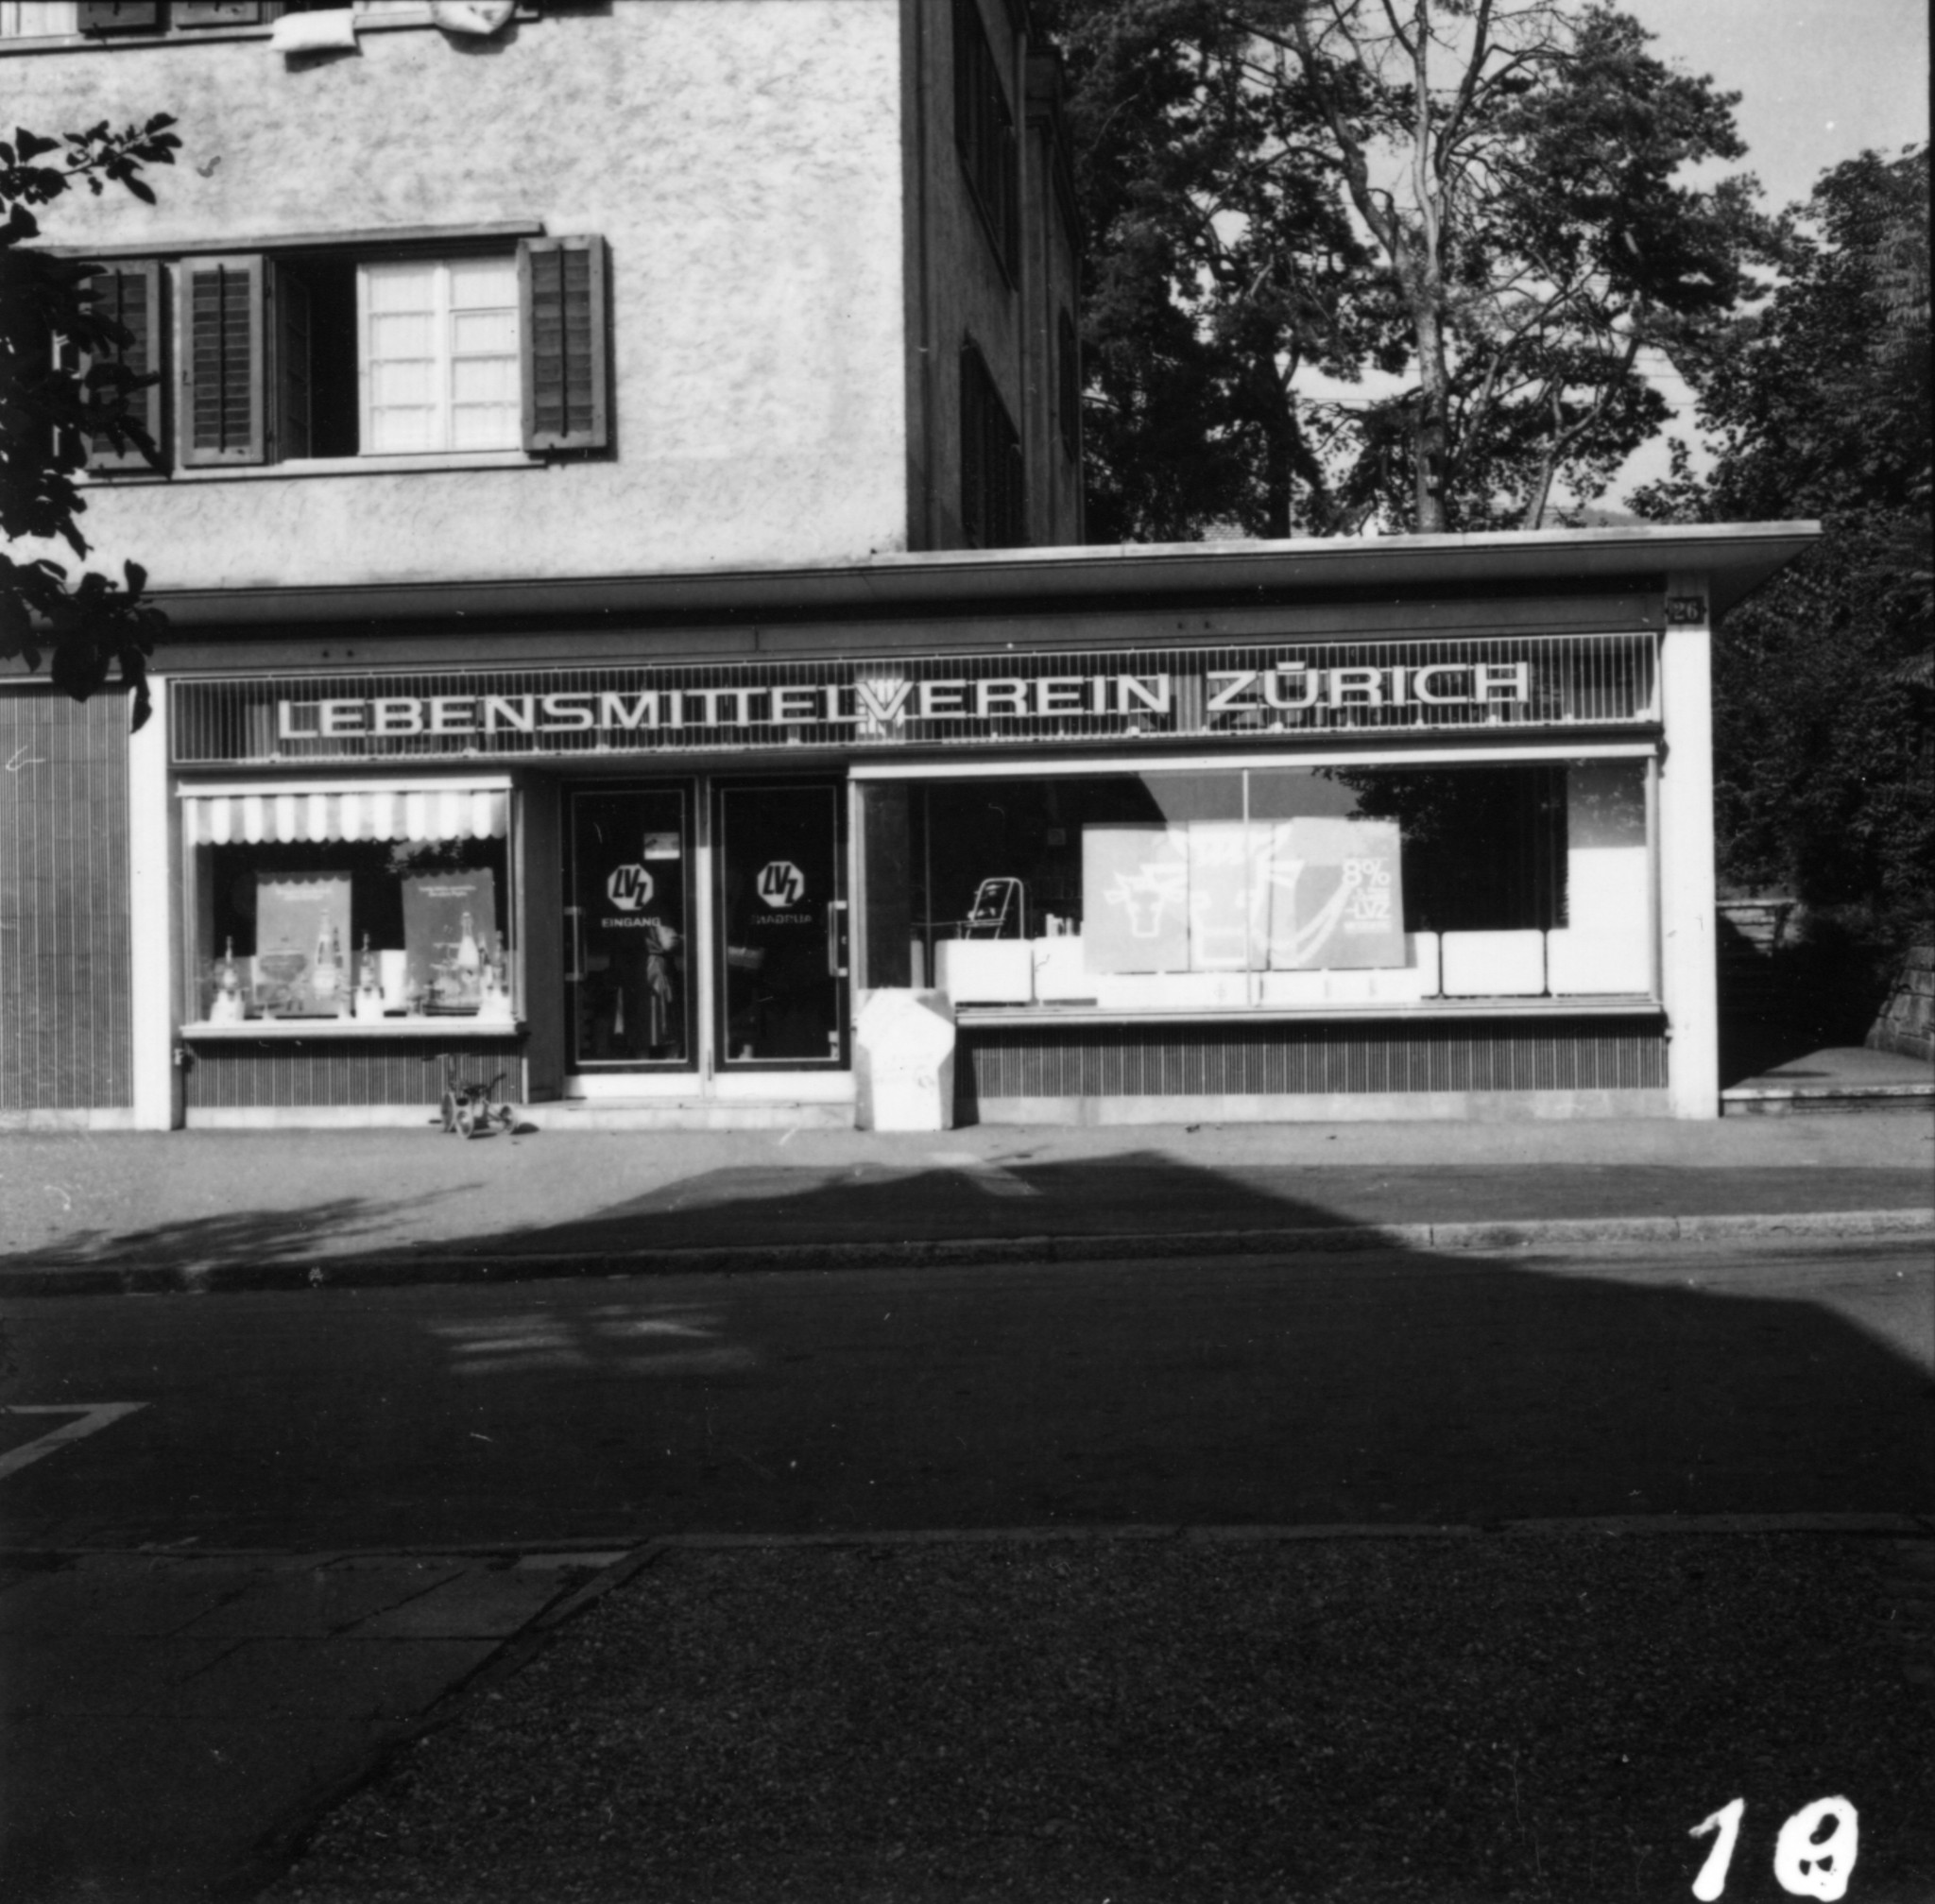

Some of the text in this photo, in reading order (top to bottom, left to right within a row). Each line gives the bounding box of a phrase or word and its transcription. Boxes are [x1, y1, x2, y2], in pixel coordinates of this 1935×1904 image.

[1673, 601, 1699, 620] 26
[279, 661, 1529, 740] LEBENSMITTELVEREIN ZÜRICH
[1343, 858, 1392, 887] 8%
[602, 917, 660, 928] EINGANG
